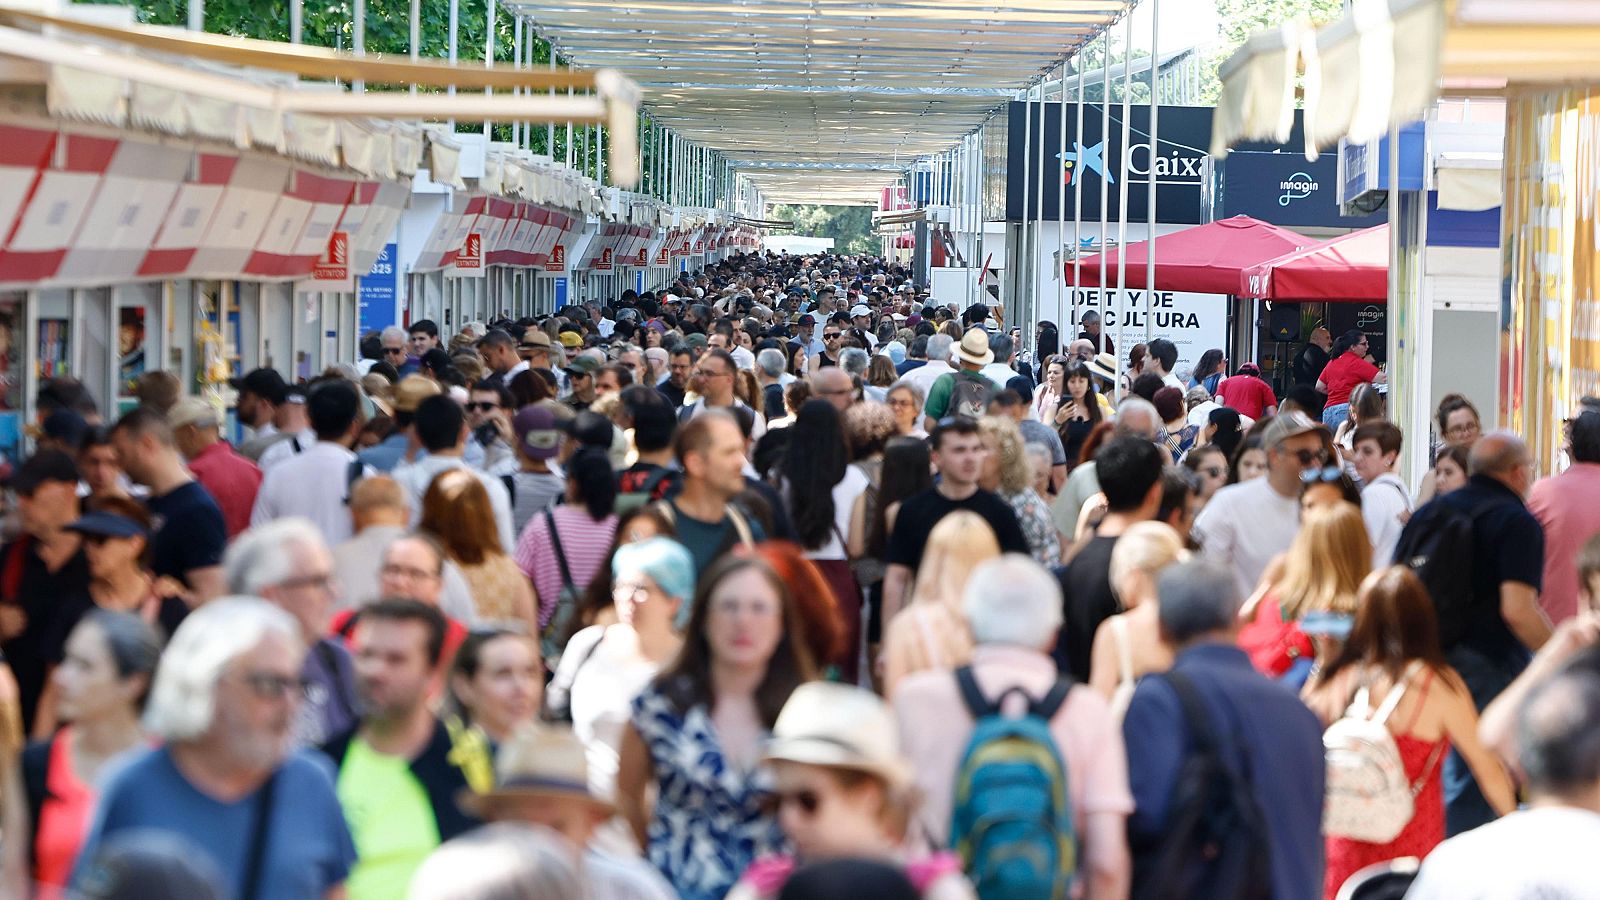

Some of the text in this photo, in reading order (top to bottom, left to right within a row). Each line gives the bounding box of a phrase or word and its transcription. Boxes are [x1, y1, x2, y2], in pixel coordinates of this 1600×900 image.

[1280, 181, 1318, 192] imagin
[1072, 290, 1099, 306] DE
[1105, 291, 1116, 306] T
[1127, 292, 1142, 306] Y
[1104, 310, 1200, 328] CULURA
